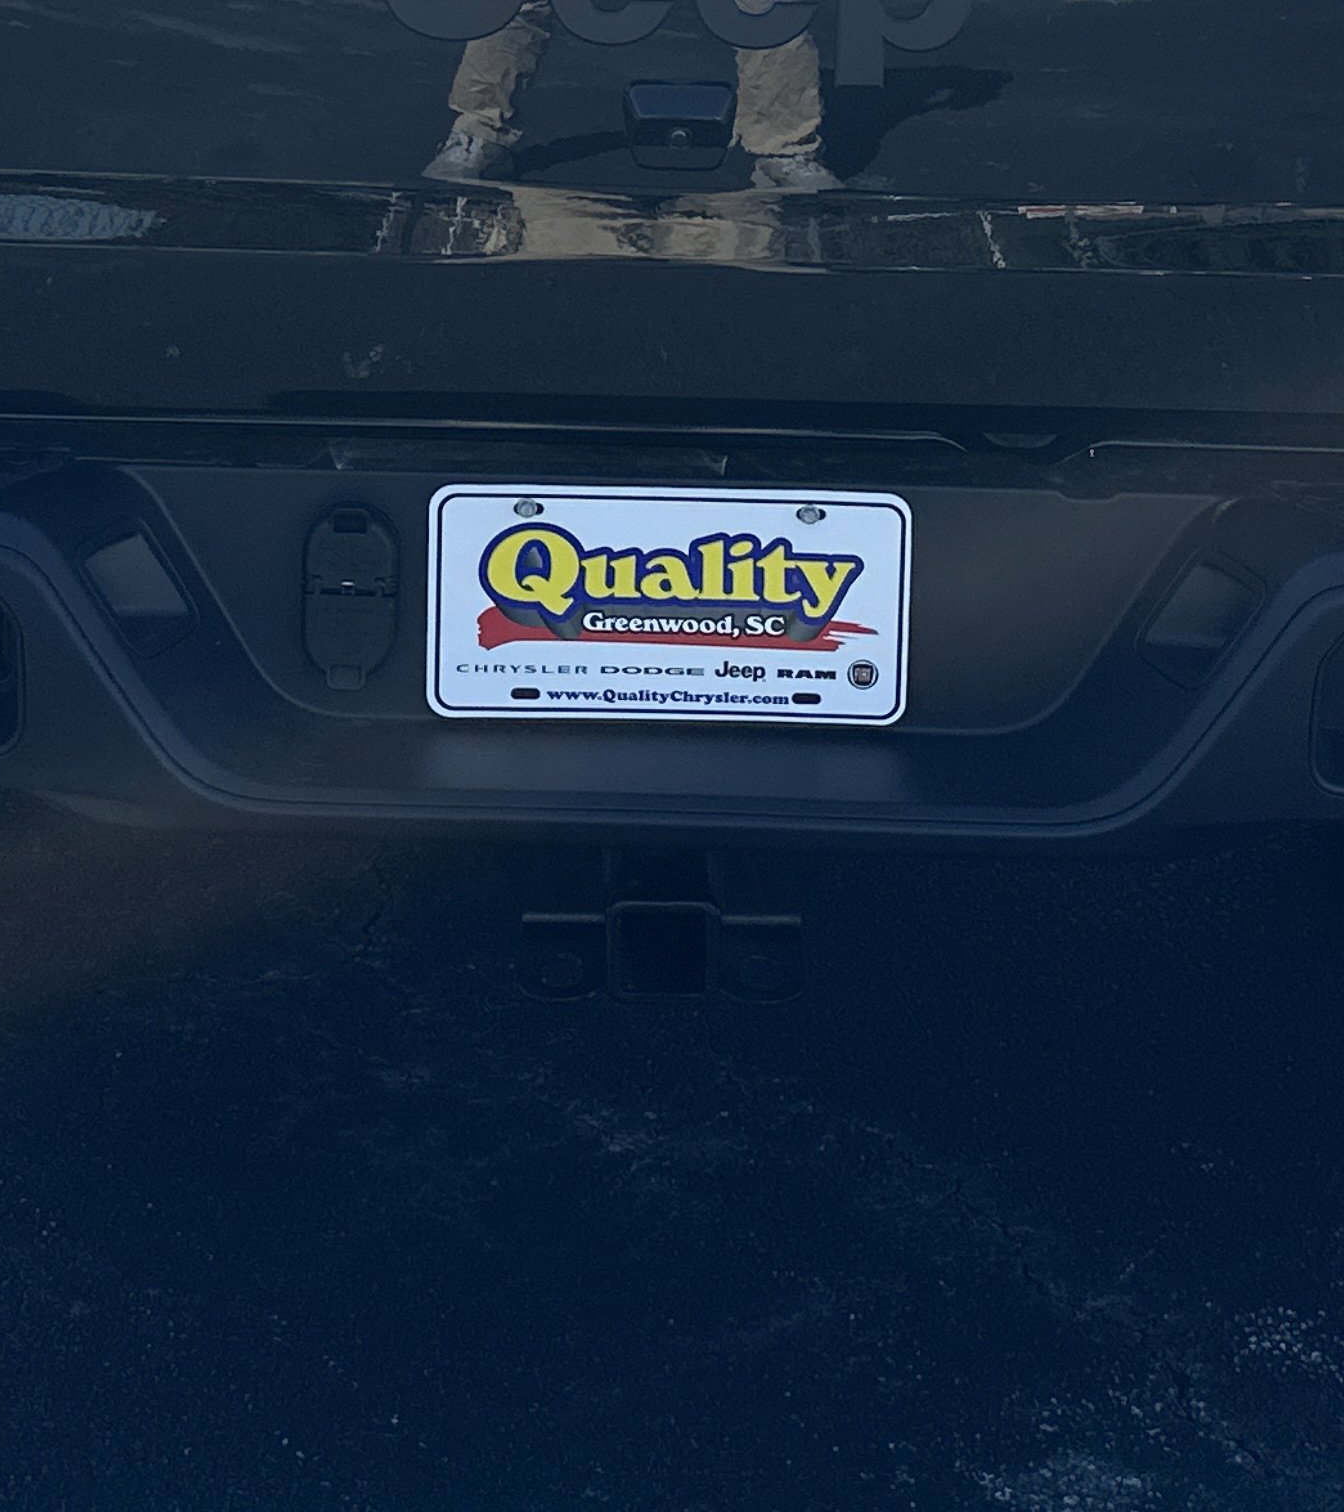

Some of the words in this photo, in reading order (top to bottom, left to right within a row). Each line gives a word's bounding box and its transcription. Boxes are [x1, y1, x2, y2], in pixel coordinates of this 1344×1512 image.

[486, 528, 856, 618] Quality
[582, 611, 739, 638] Greenwood,
[745, 615, 785, 637] SC
[455, 663, 589, 675] CHRYSLER
[600, 665, 705, 676] DODGE
[714, 660, 767, 682] Jeep
[776, 668, 837, 680] RAM
[546, 688, 790, 705] www.QualityChrysler.com
